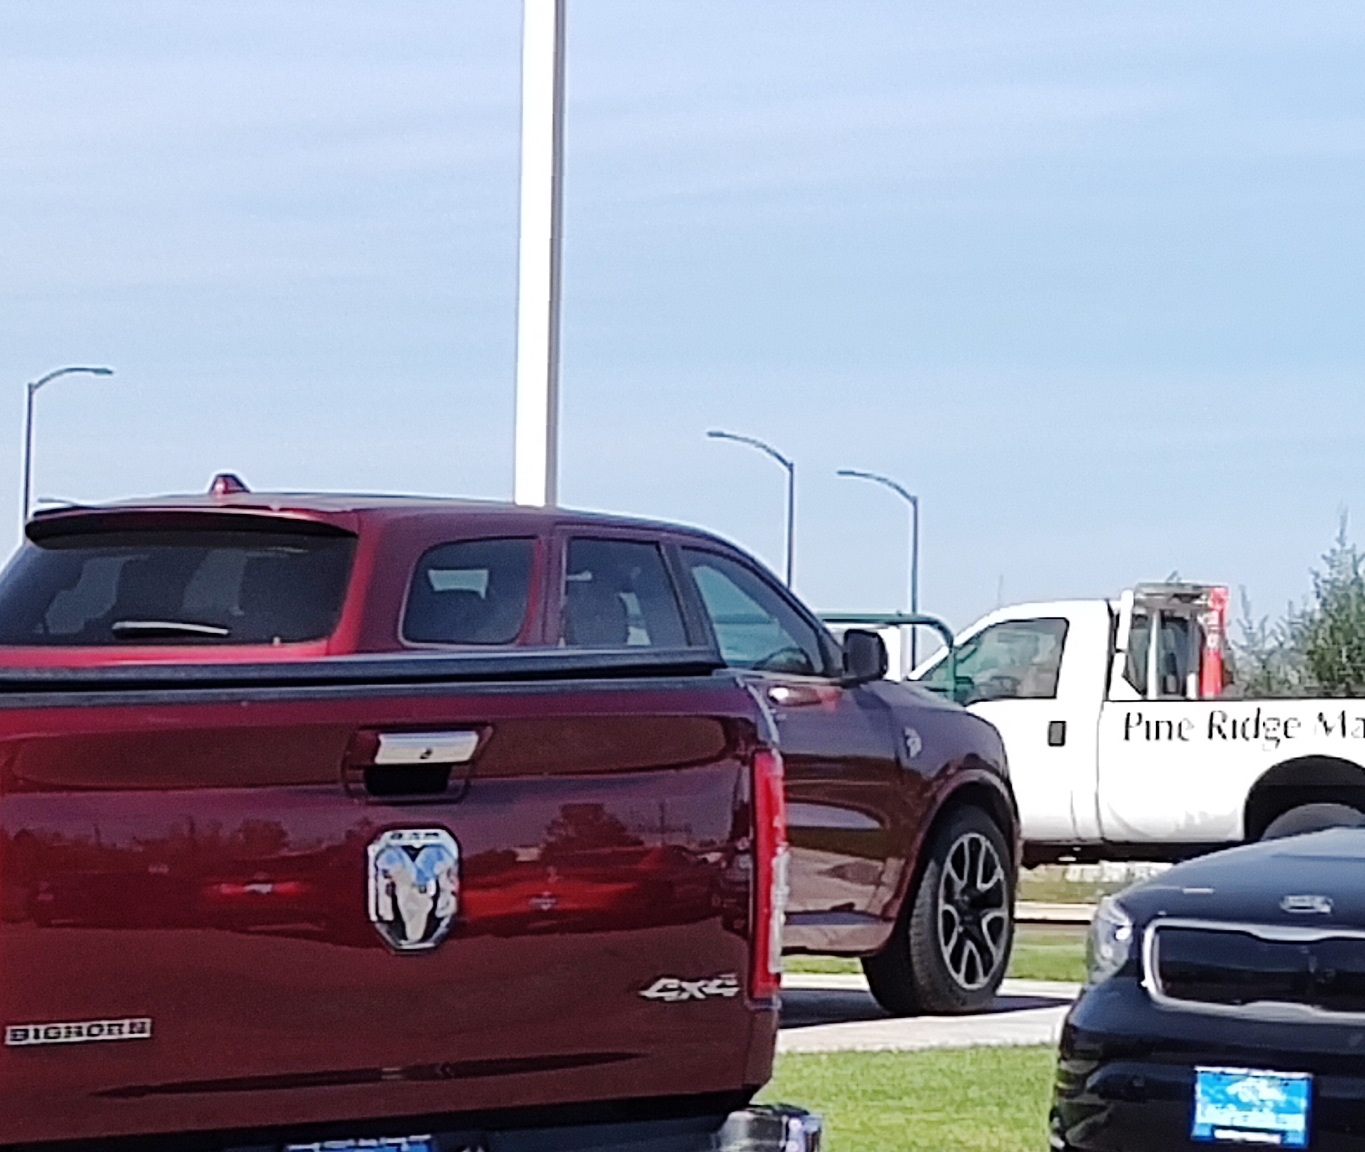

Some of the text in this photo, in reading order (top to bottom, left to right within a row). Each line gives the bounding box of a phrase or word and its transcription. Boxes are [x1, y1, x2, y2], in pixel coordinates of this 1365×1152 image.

[1123, 710, 1195, 741] Pine
[1206, 706, 1302, 752] Ridge
[7, 1019, 150, 1044] BIGHORN
